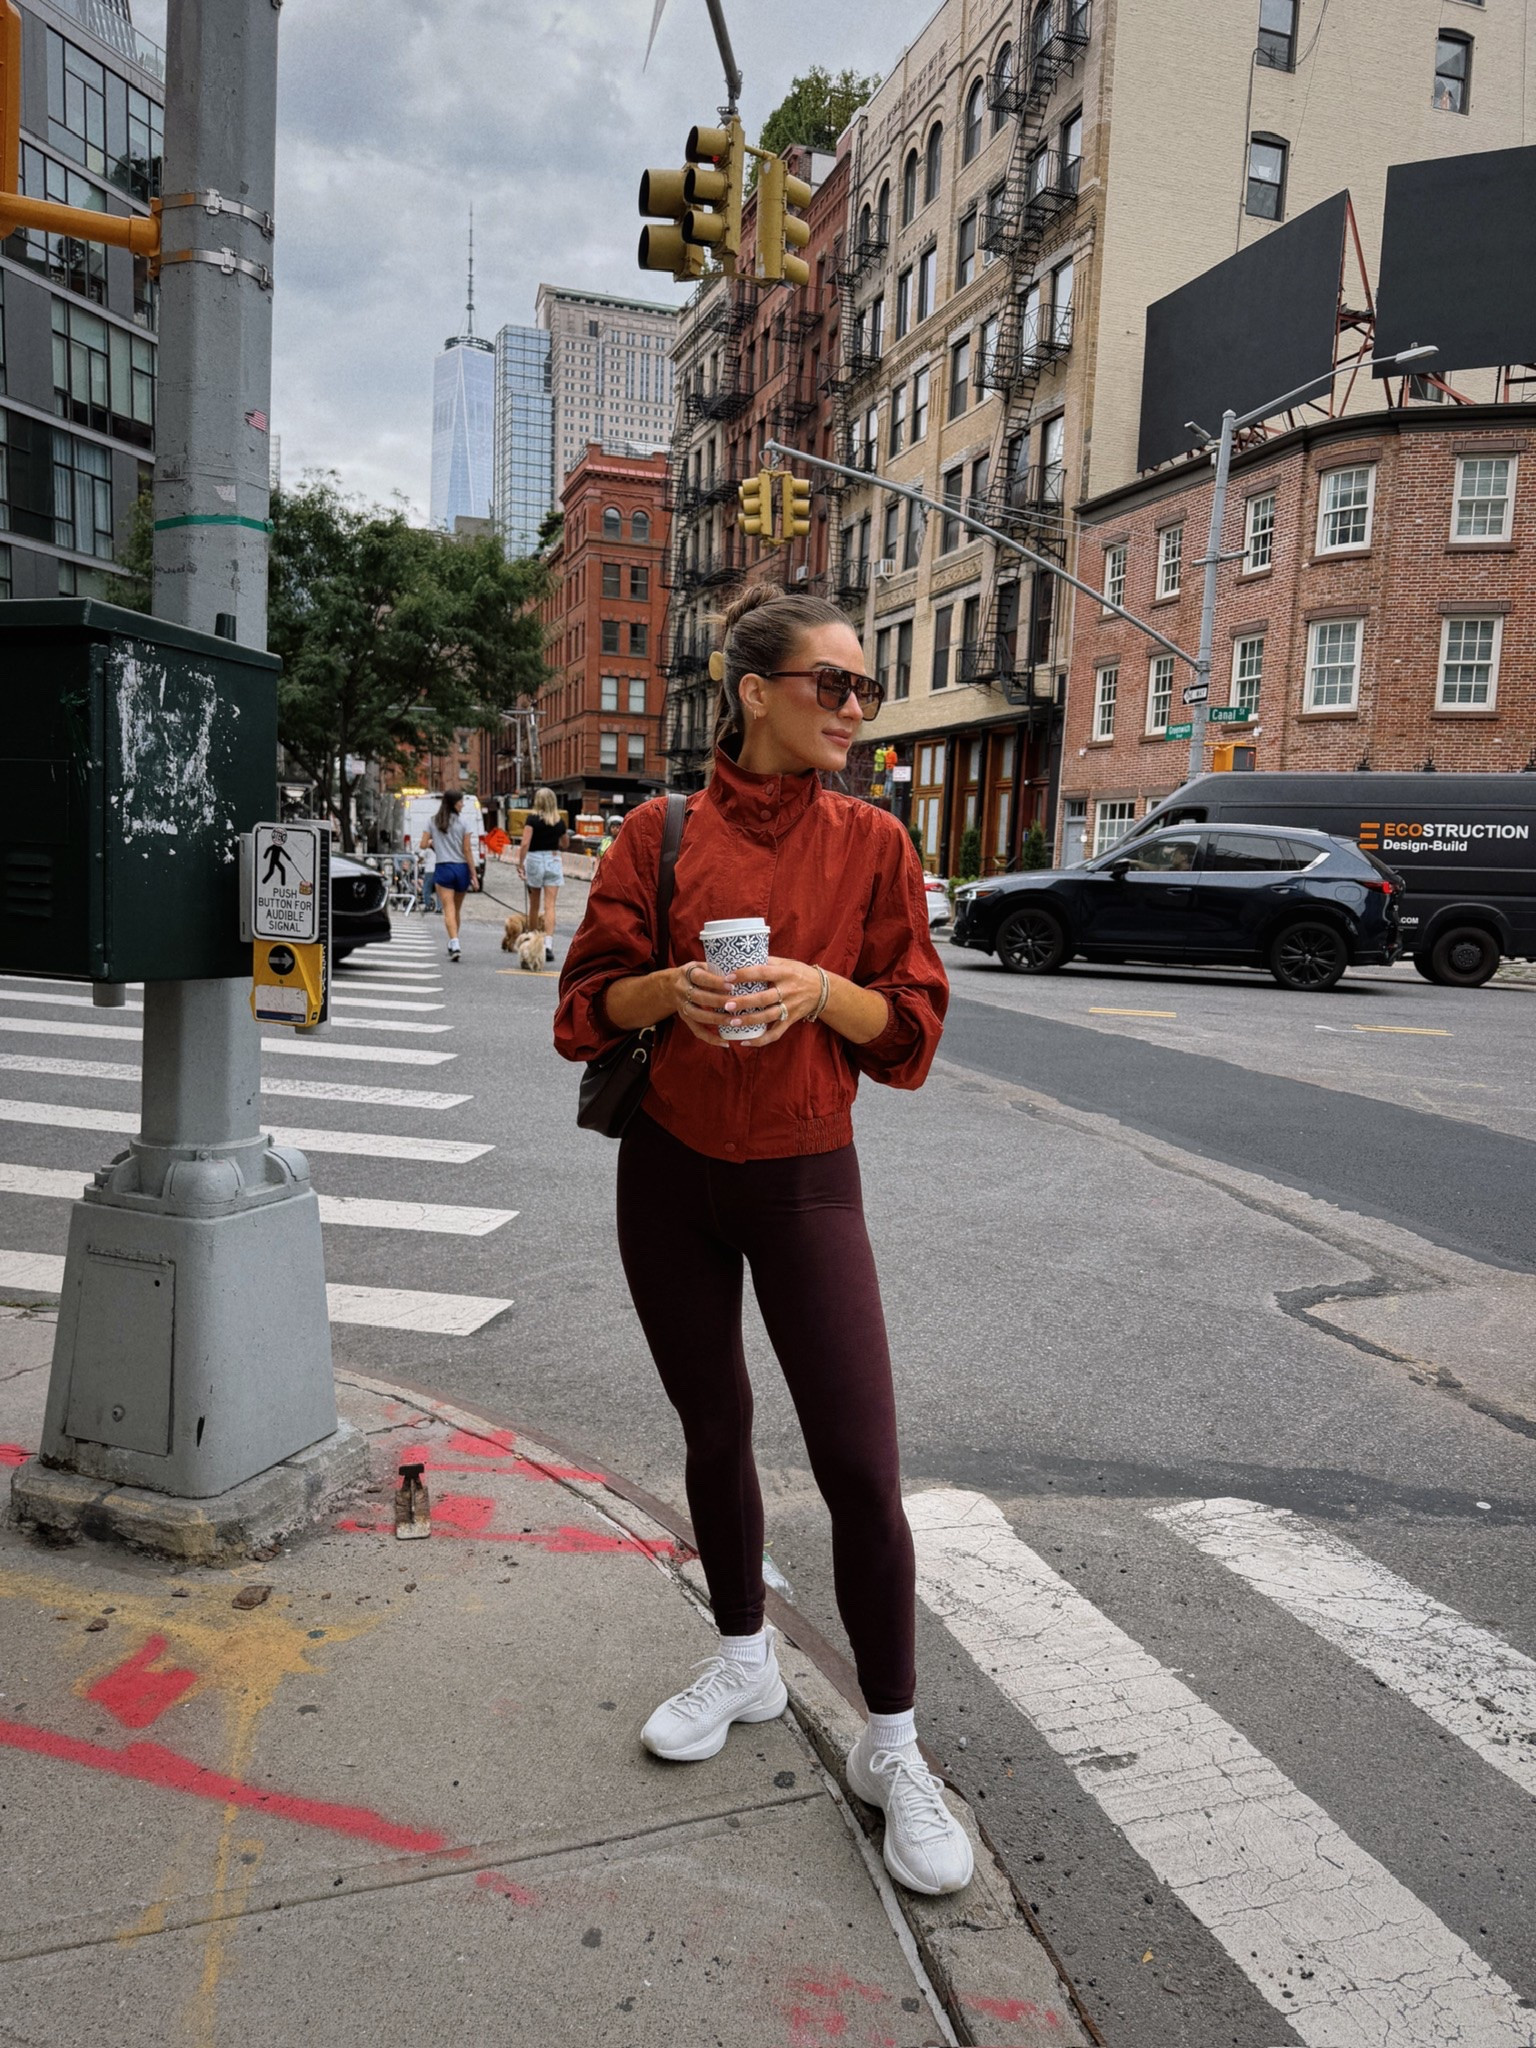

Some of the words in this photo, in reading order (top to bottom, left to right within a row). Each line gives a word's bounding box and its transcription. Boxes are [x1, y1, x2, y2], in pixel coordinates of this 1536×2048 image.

[1212, 709, 1236, 720] Canal
[1384, 823, 1529, 839] ECOSTRUCTION
[1383, 839, 1468, 852] Design-Build
[273, 887, 298, 899] PUSH
[258, 897, 293, 909] BUTTON
[295, 900, 312, 911] FOR
[266, 908, 304, 922] AUDIBLE
[269, 920, 301, 932] SIGNAL
